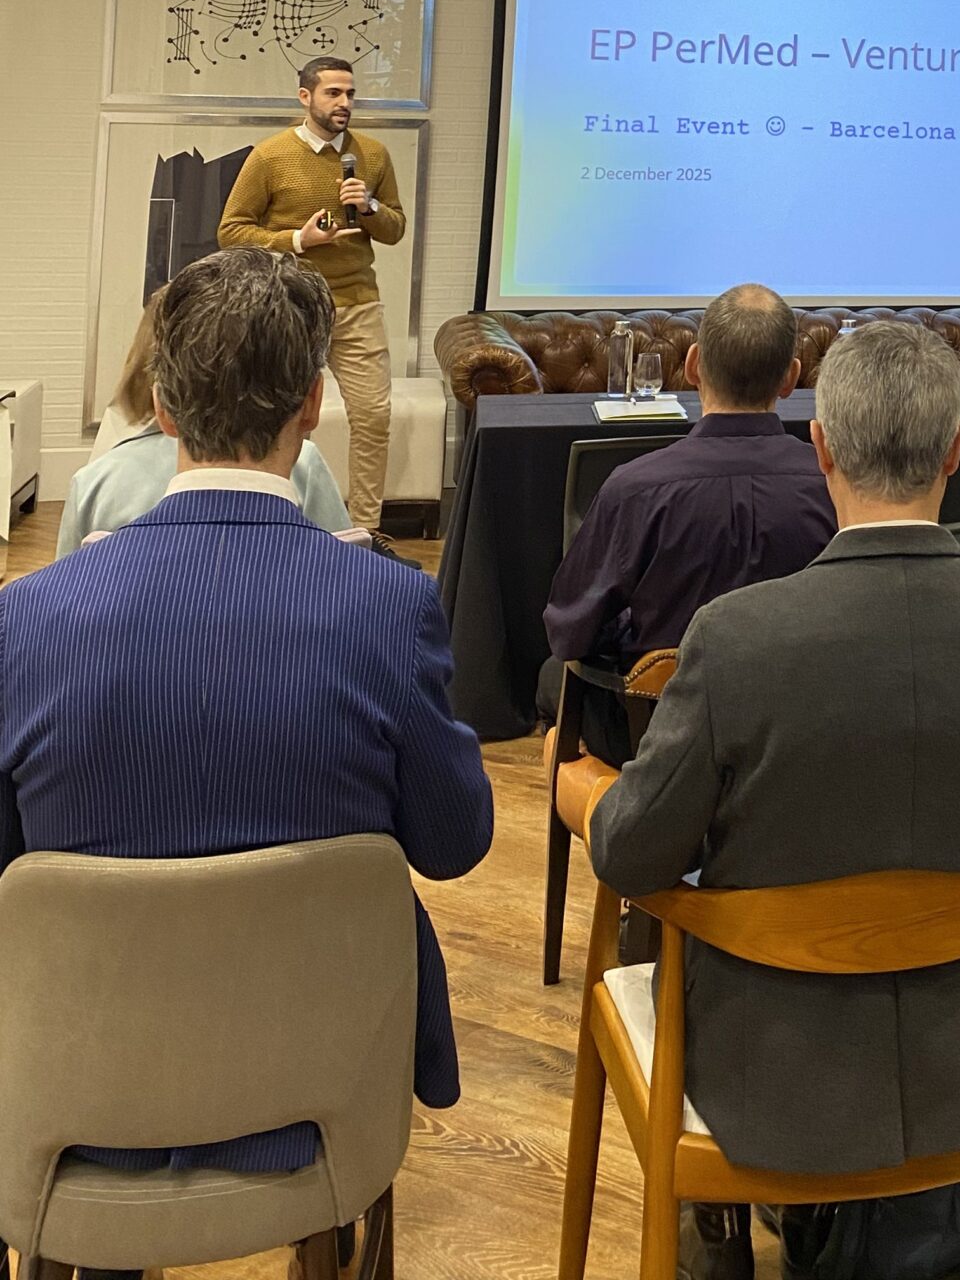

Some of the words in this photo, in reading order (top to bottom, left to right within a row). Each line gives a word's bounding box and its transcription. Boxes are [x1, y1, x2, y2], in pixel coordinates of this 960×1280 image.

[591, 29, 637, 61] EP
[652, 31, 799, 68] PerMed
[584, 114, 660, 135] Final
[676, 118, 751, 136] Event
[829, 120, 957, 140] Barcelona
[580, 166, 590, 180] 2
[594, 166, 673, 181] December
[676, 167, 712, 182] 2025
